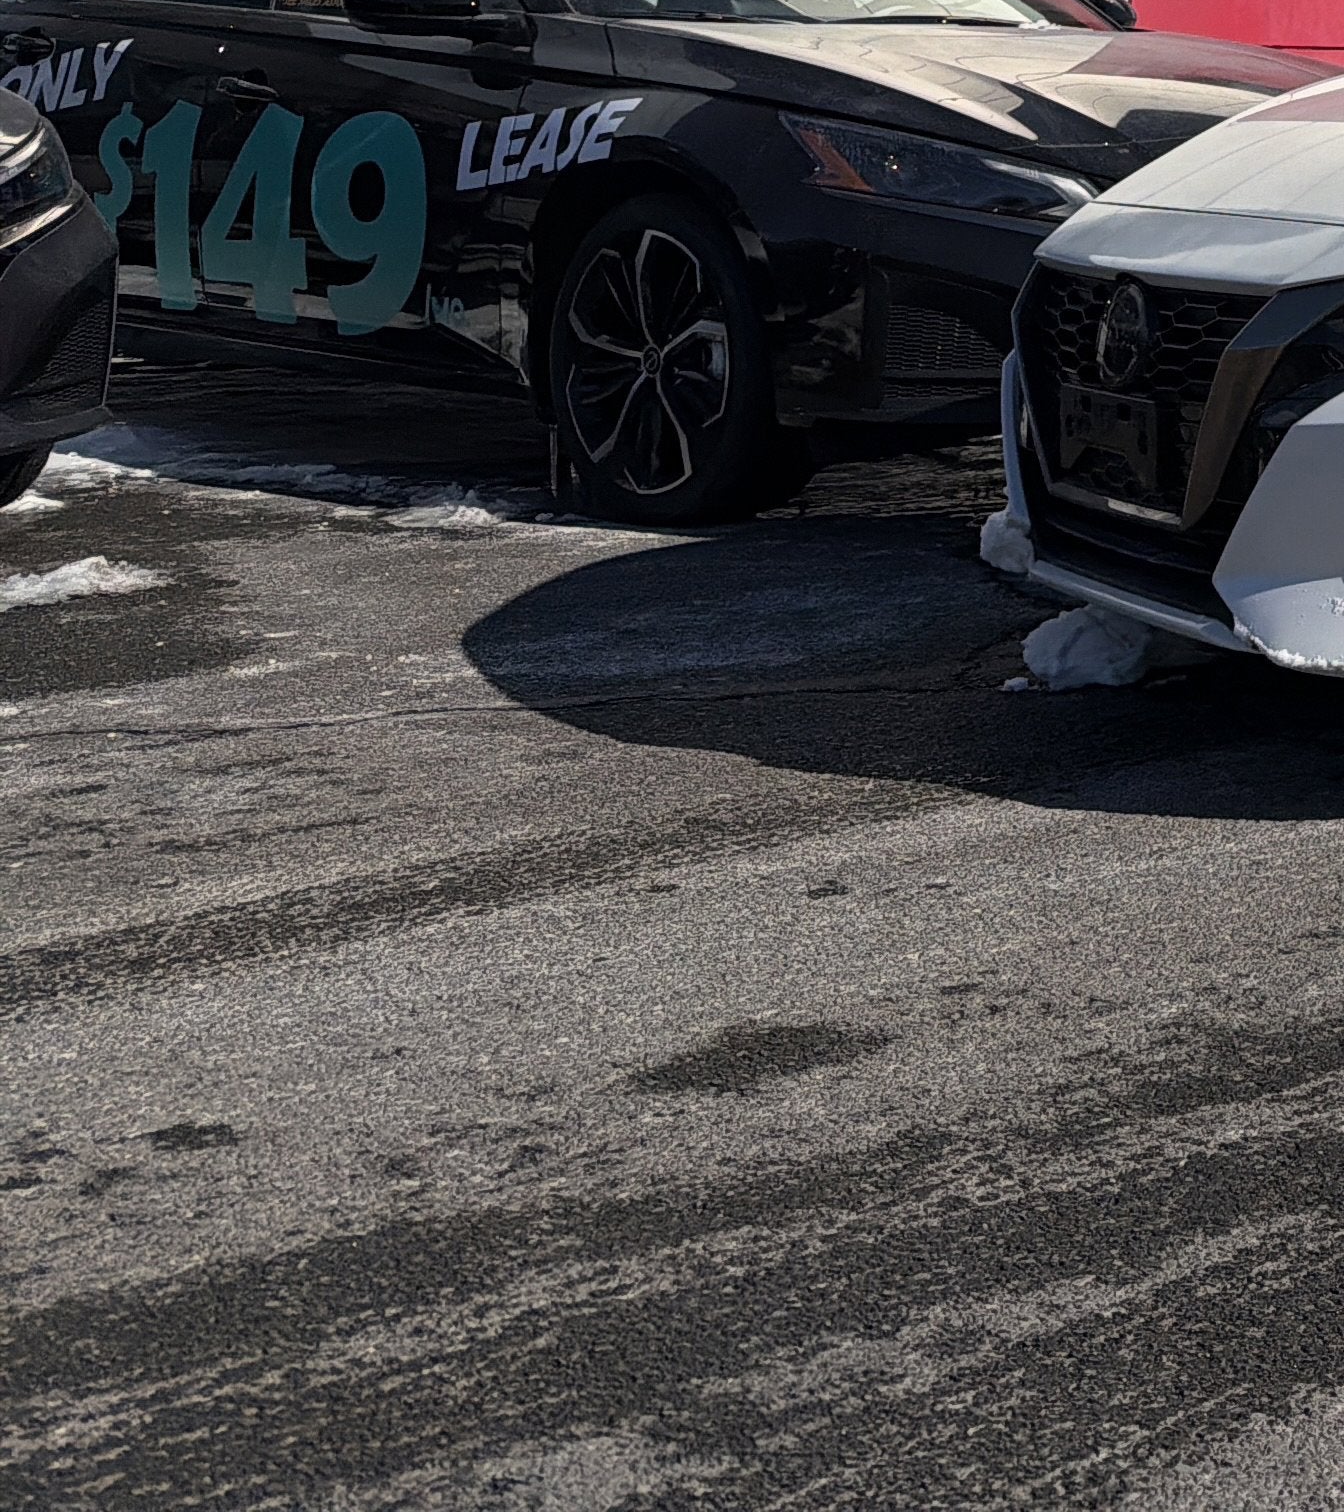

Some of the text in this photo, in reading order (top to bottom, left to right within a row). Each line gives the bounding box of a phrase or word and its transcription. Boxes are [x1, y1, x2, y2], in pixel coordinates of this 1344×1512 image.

[0, 38, 134, 113] ONLY
[456, 97, 644, 191] LEASE
[95, 99, 427, 336] $149
